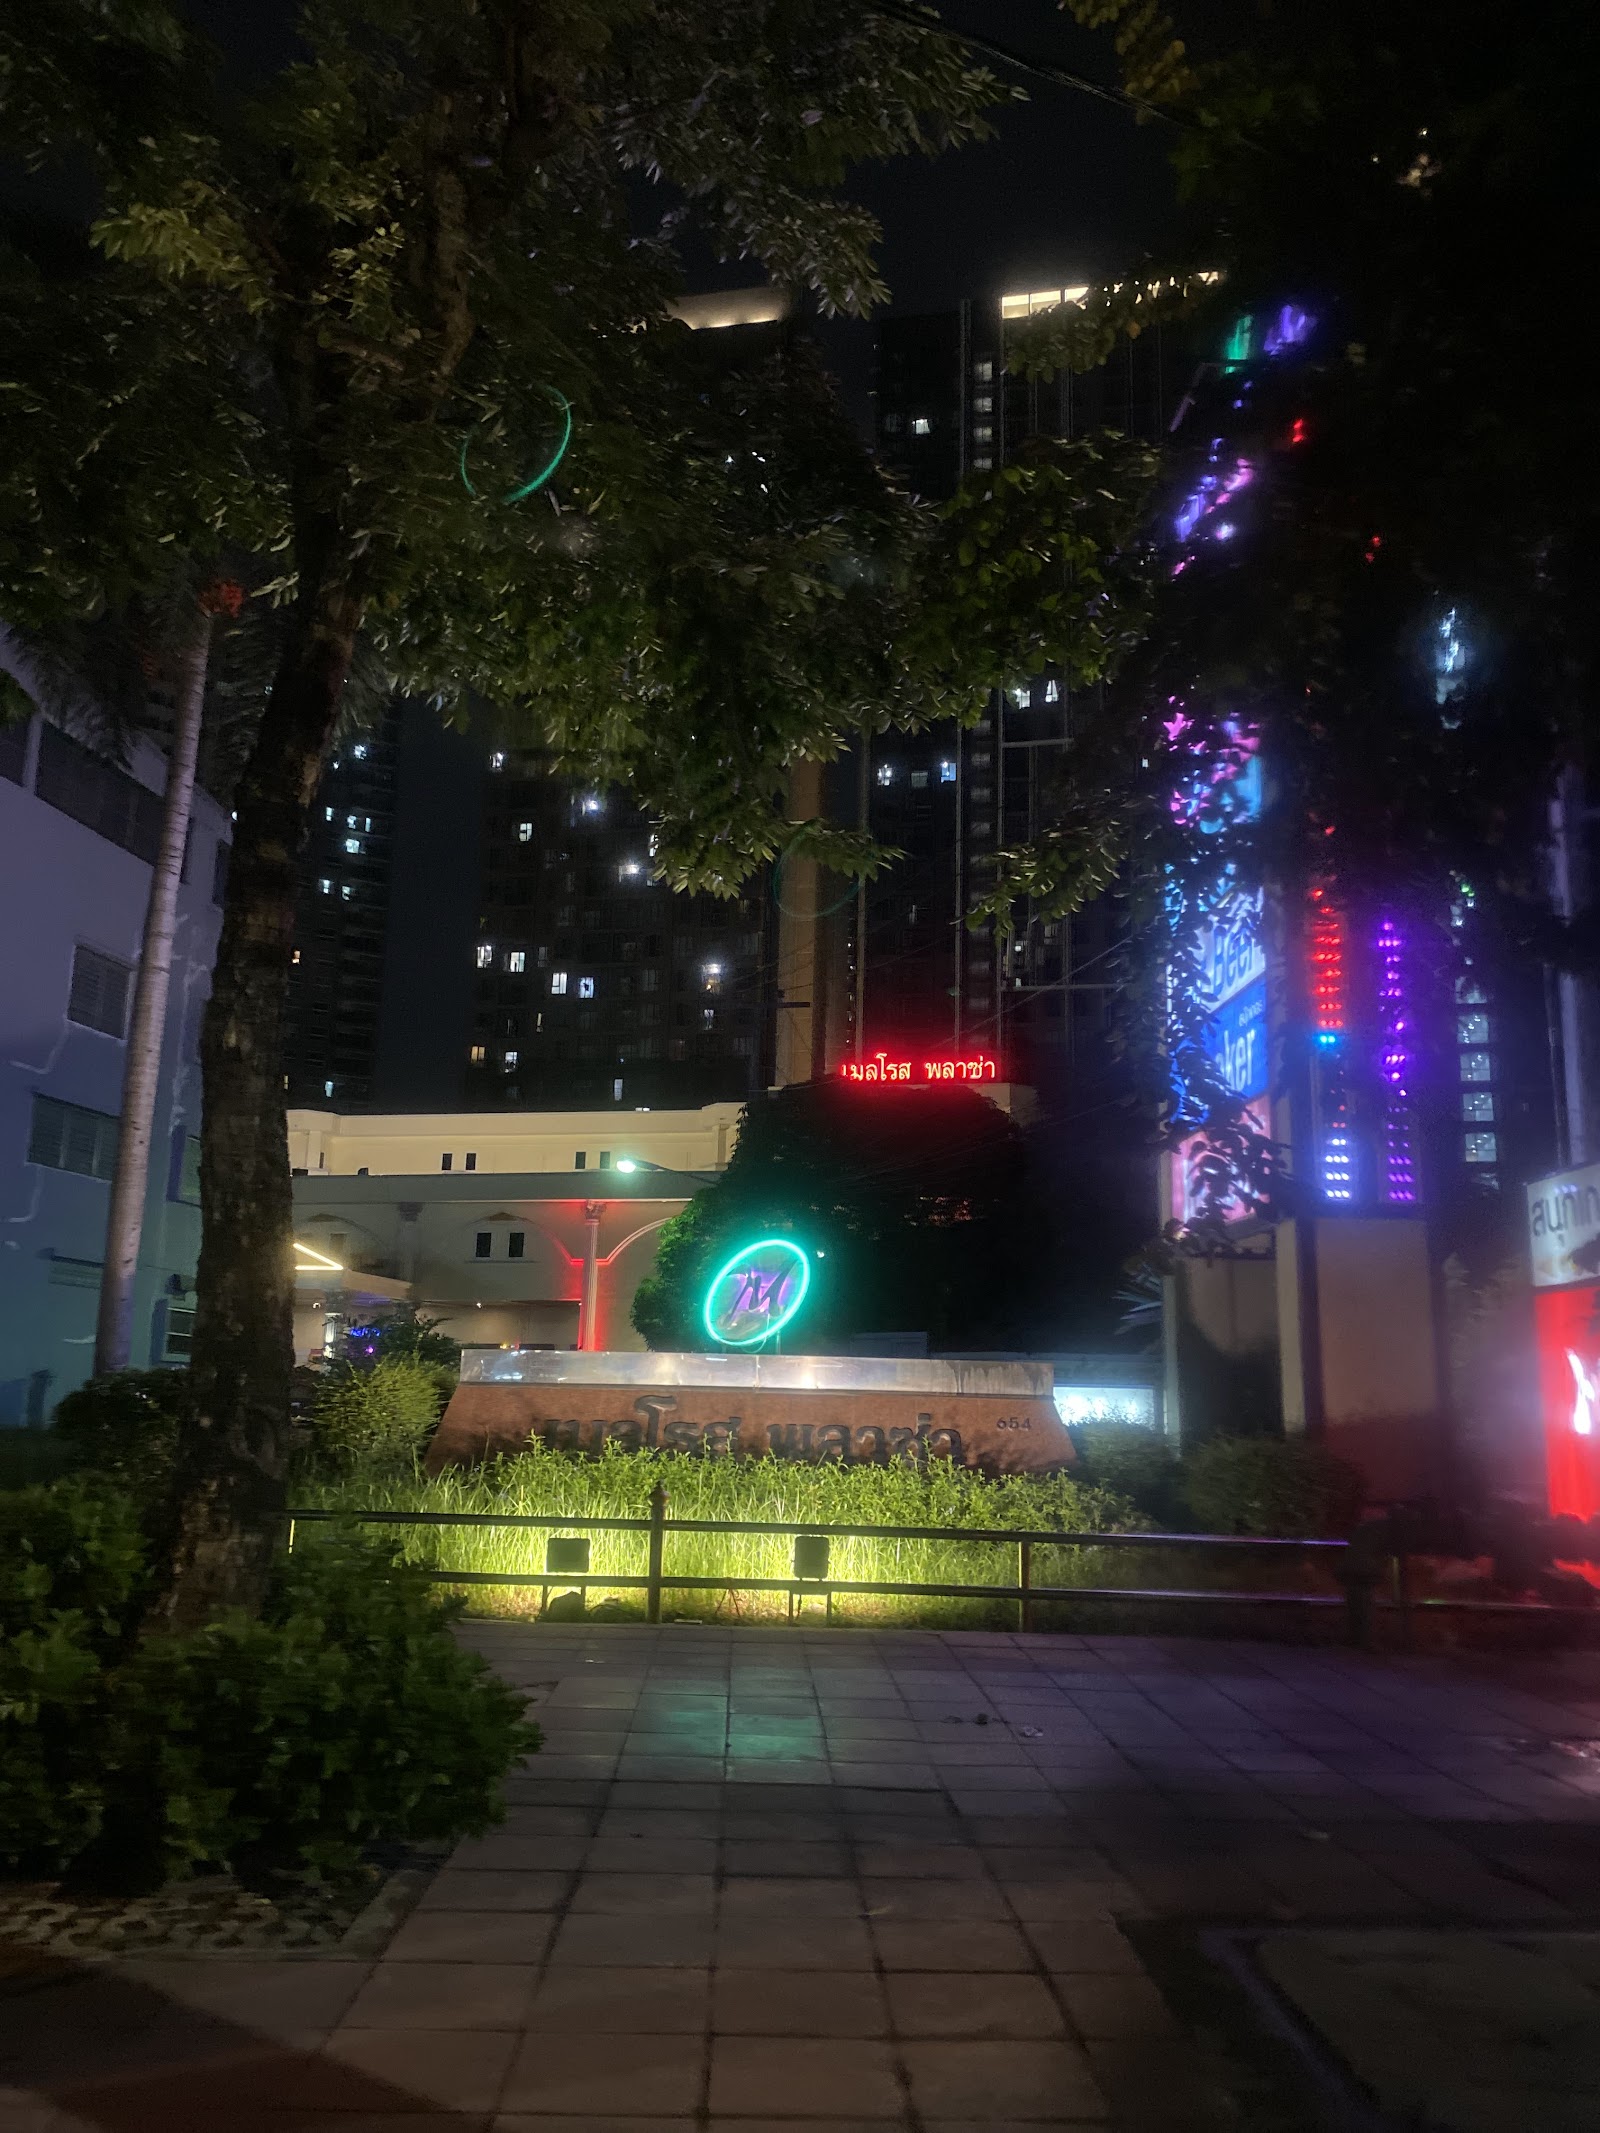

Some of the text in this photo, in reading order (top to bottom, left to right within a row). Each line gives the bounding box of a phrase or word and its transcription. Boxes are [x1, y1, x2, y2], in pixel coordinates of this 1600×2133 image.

[841, 1052, 996, 1082] เมลโรส พลาซ่า
[996, 1417, 1032, 1431] 654
